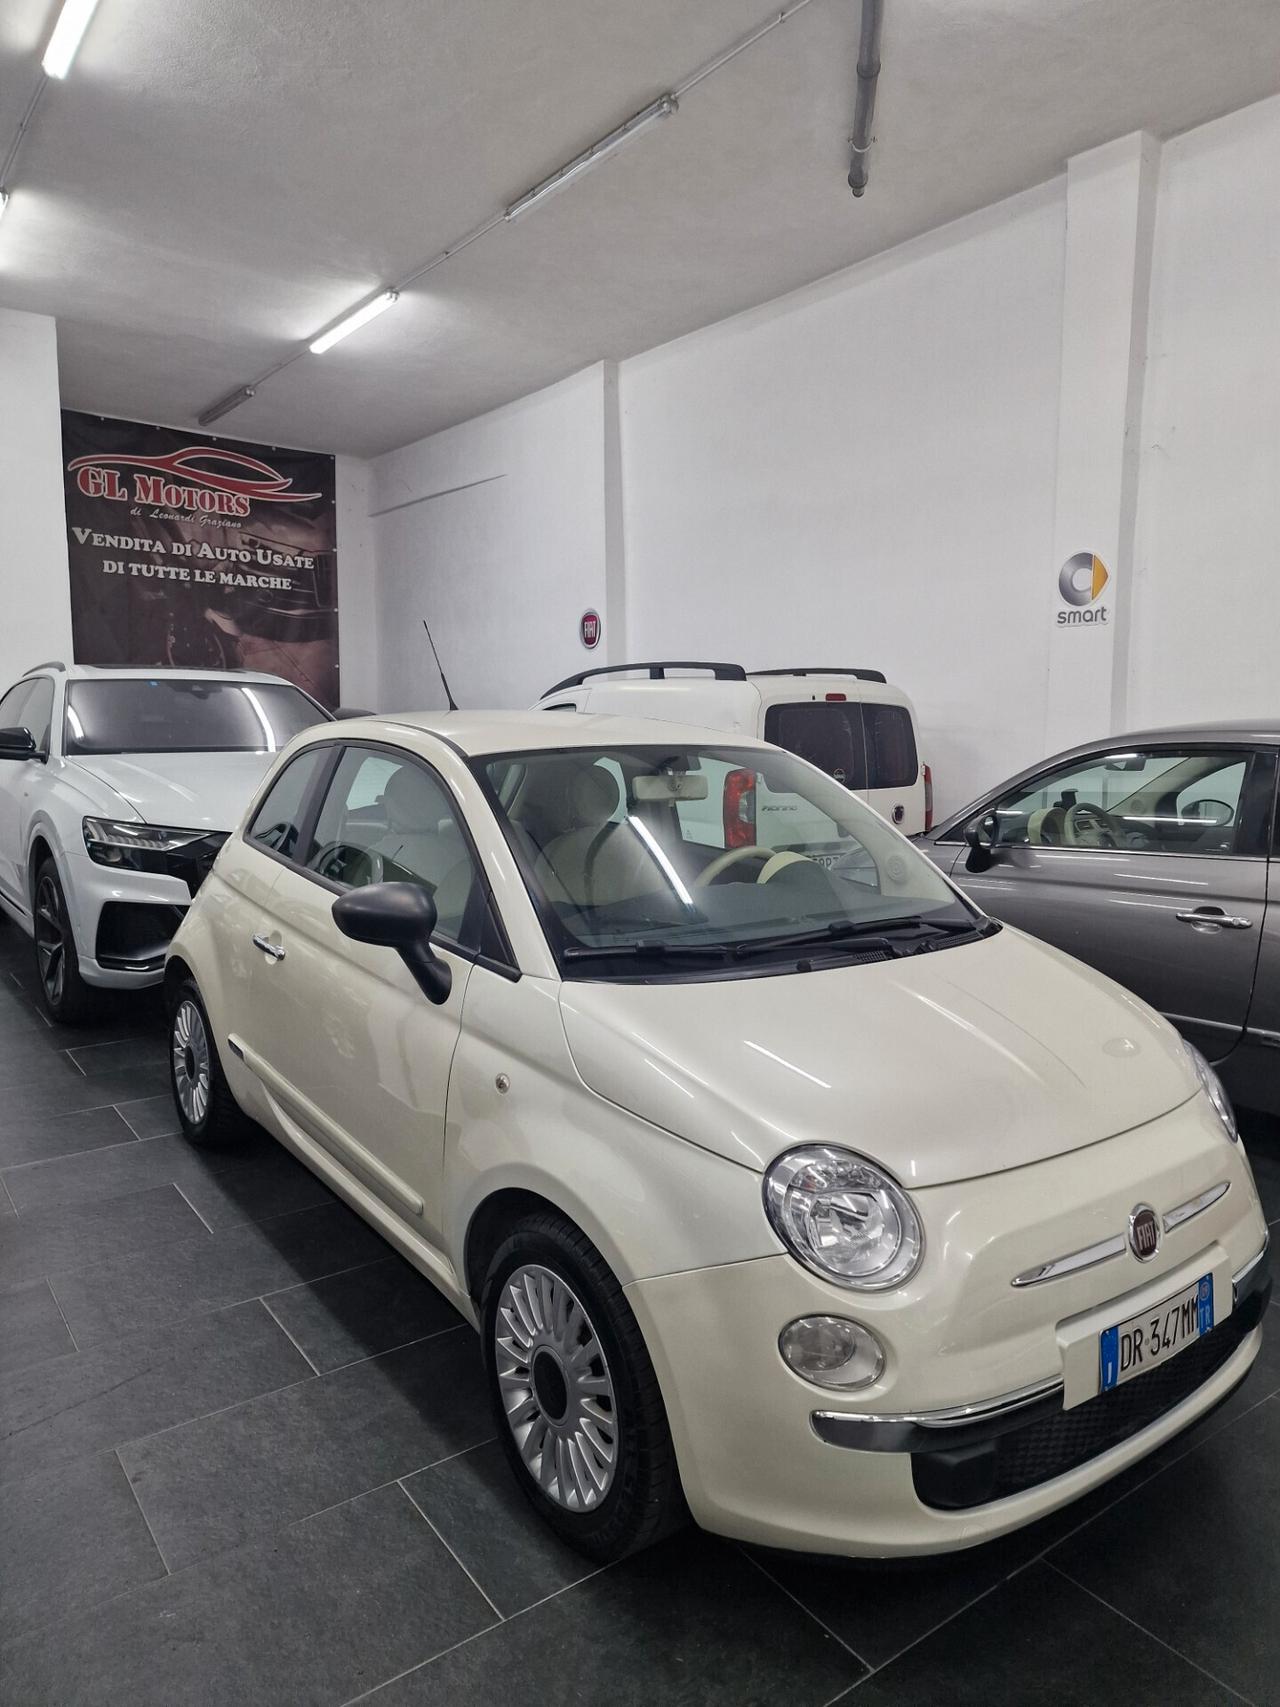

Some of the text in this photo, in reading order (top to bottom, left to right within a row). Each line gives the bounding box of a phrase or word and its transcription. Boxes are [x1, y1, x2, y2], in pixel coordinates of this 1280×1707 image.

[77, 466, 250, 517] GL MOTORS
[72, 527, 166, 554] VENDITA
[198, 542, 251, 564] AUTO
[256, 551, 314, 570] USATE
[103, 560, 292, 590] DI TUTTE LE MARCHE
[1057, 606, 1107, 624] smart
[1137, 1221, 1155, 1250] FIAT
[1120, 1328, 1144, 1372] DR
